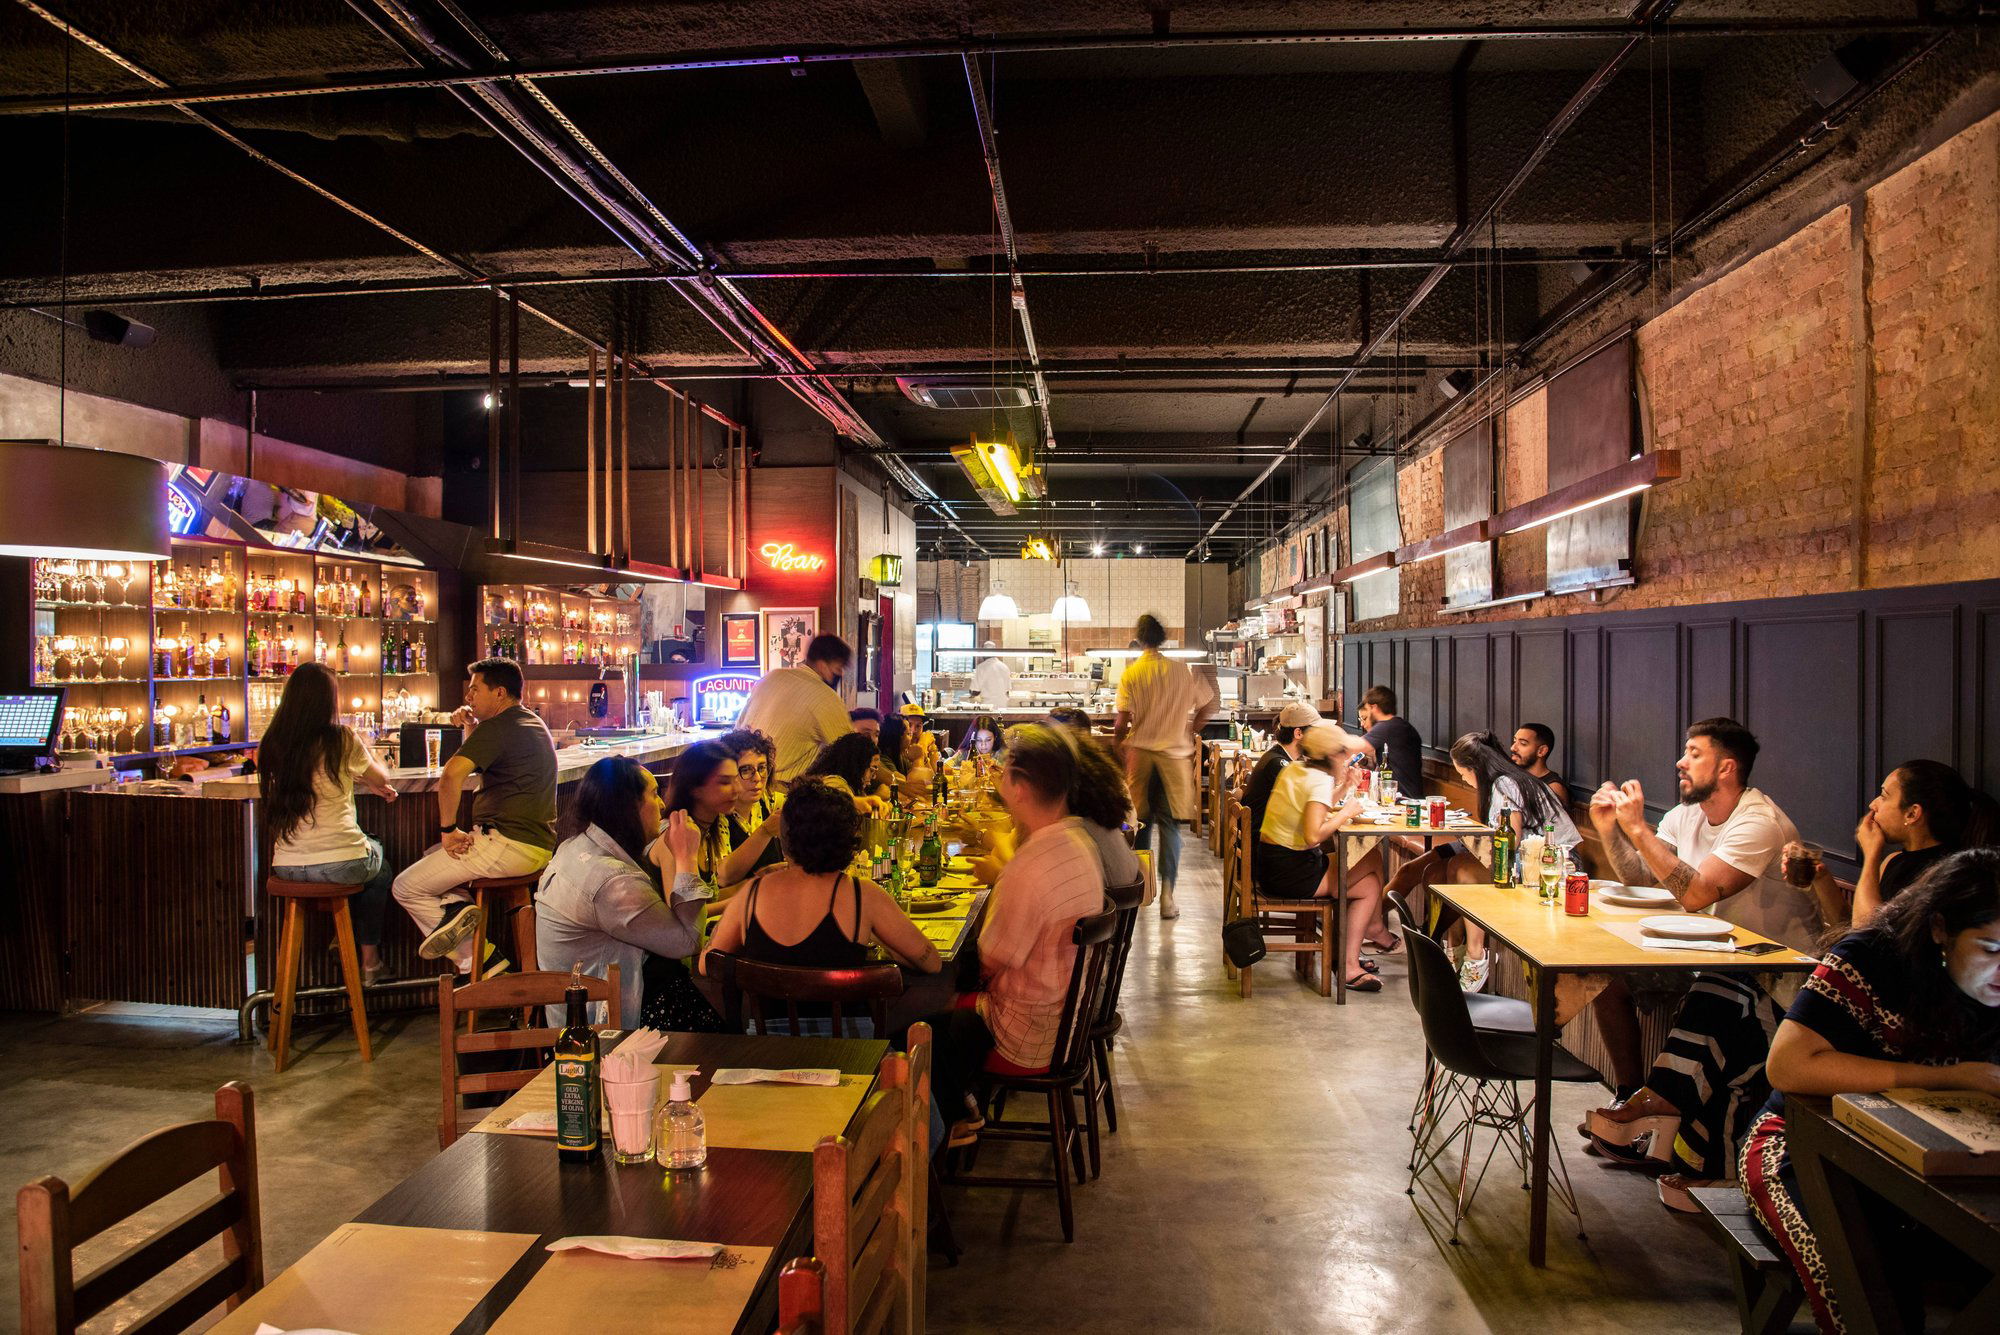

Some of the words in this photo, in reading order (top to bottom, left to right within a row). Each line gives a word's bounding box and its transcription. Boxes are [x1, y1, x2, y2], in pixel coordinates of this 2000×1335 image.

[760, 543, 824, 571] Bar
[886, 557, 904, 583] WC
[698, 678, 757, 694] LAGUNIT
